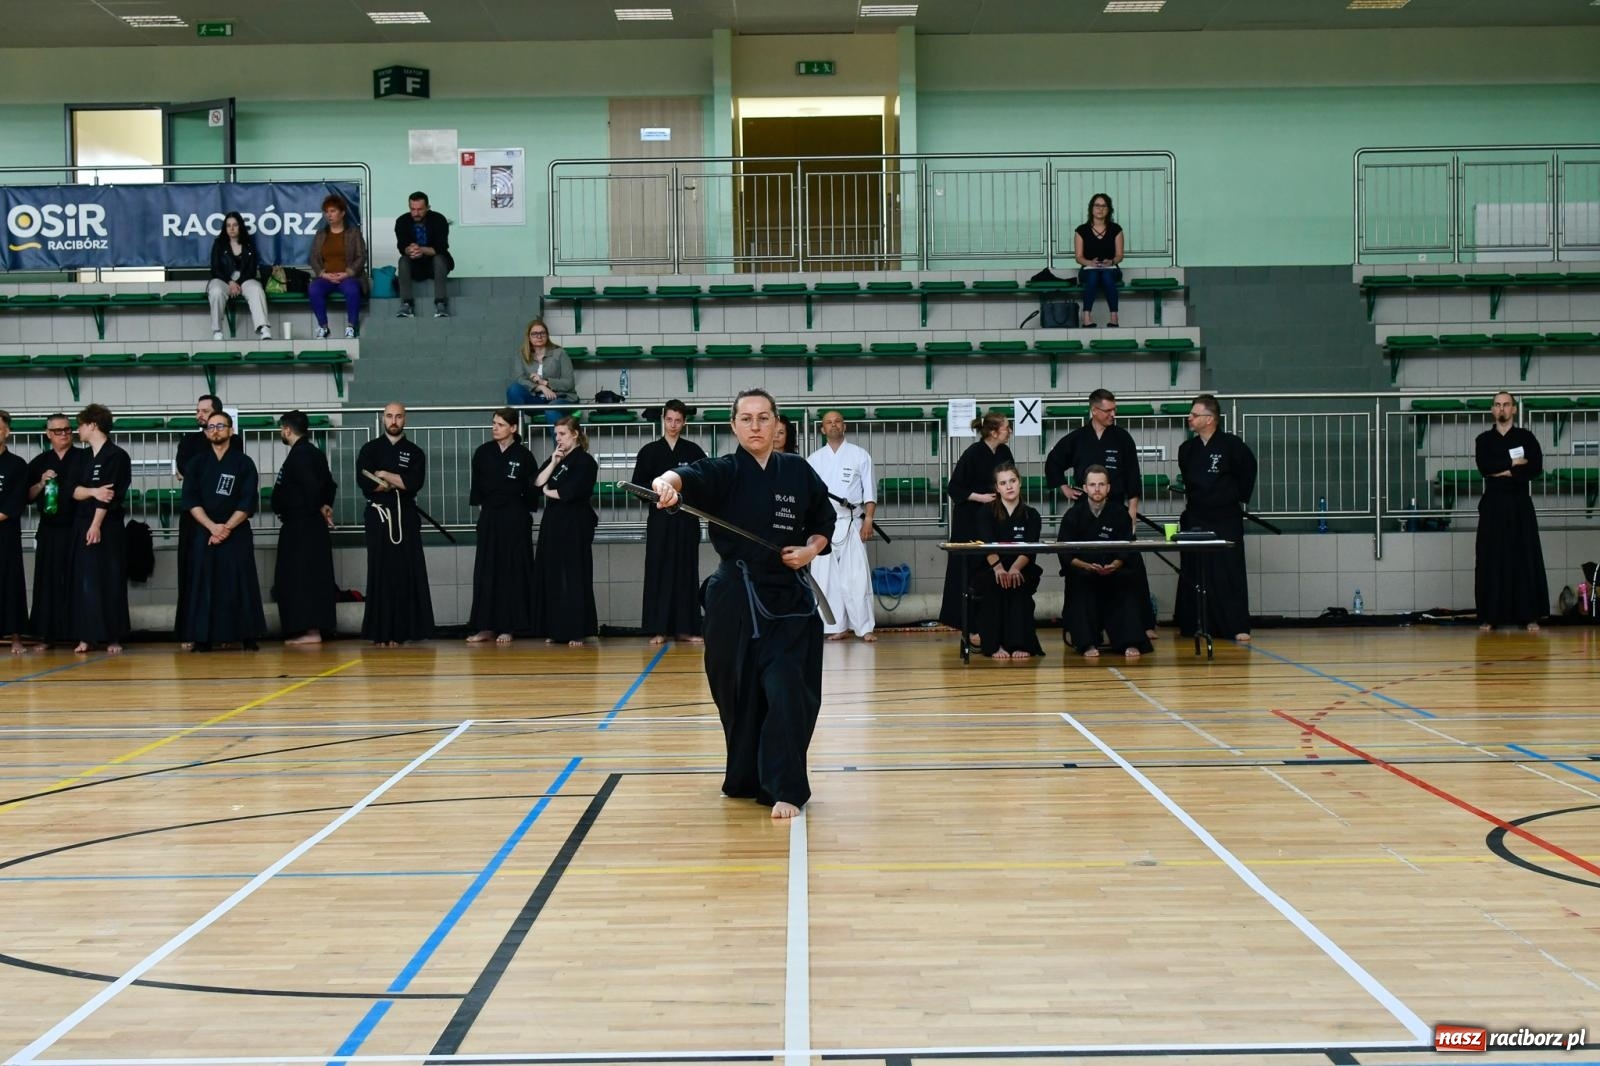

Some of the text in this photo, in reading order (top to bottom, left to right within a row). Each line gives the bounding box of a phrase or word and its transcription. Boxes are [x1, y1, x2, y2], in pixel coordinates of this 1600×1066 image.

[380, 77, 391, 95] F
[406, 76, 421, 93] F
[162, 204, 324, 237] RACBÓRZ
[47, 237, 109, 250] RACIBÓRZ
[1018, 399, 1040, 424] X
